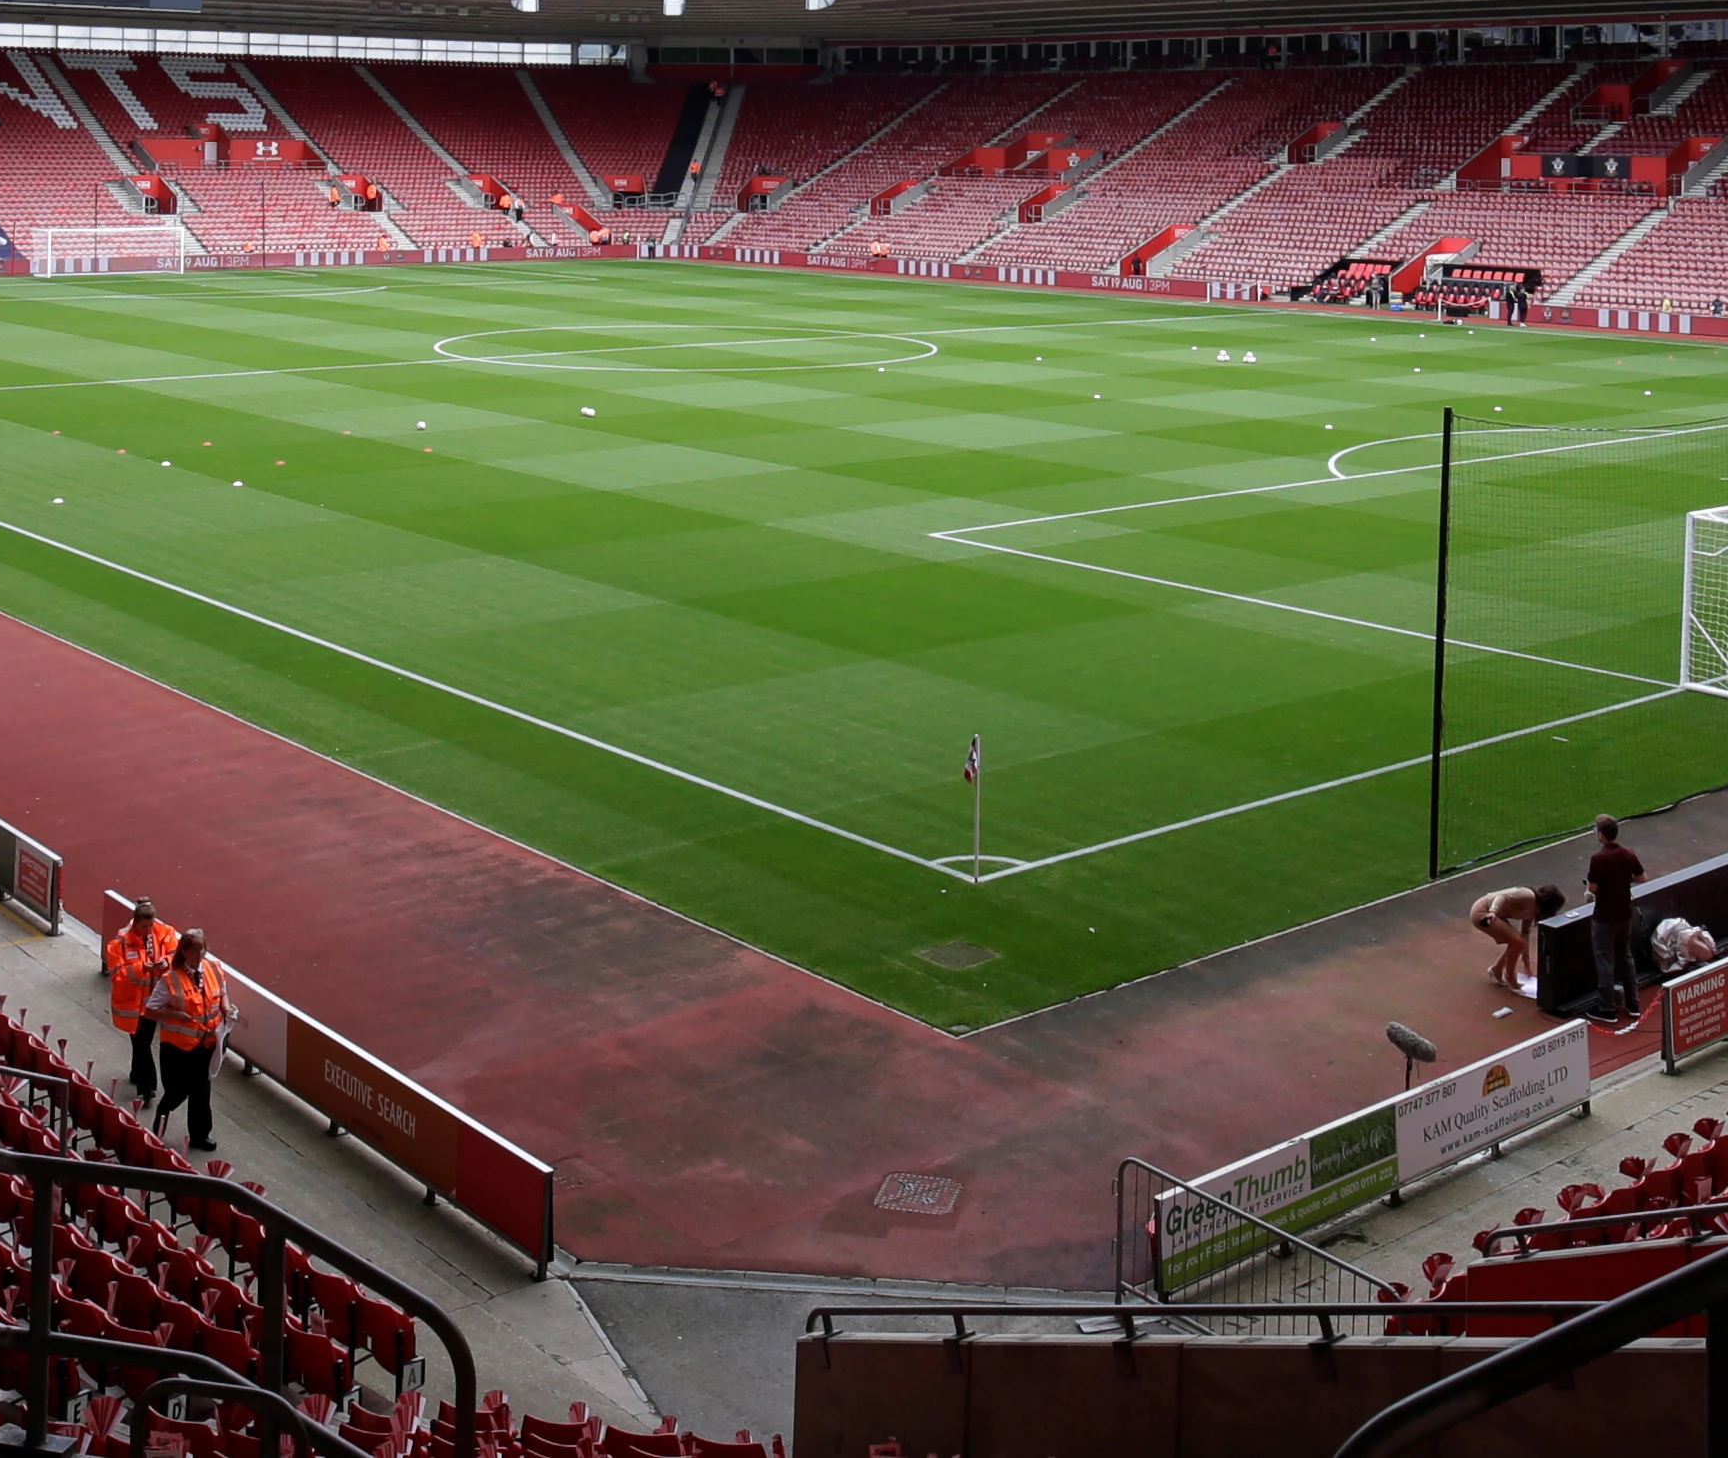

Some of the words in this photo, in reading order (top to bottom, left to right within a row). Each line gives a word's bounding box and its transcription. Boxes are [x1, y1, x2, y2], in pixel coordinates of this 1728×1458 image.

[157, 257, 179, 268] SAT
[194, 256, 217, 267] AUG
[526, 248, 543, 258] SAT
[1091, 275, 1111, 287] SAT
[1122, 278, 1143, 289] AUG
[1150, 279, 1170, 292] 3PM
[1677, 973, 1725, 1004] WARNING
[1532, 1043, 1547, 1060] 023
[324, 1058, 373, 1110] EXECUTIVE
[377, 1093, 416, 1139] SEARCH
[1397, 1097, 1423, 1118] 07747
[1425, 1088, 1440, 1106] 377
[1422, 1114, 1453, 1142] KAM
[1454, 1102, 1490, 1130] Quality
[1492, 1076, 1546, 1113] Scaffolding
[1547, 1065, 1568, 1088] LTD
[1440, 1095, 1555, 1155] www.kam-scaffolding.co.uk
[1165, 1154, 1308, 1237] GreenThumb
[1173, 1230, 1200, 1248] LAWN
[1263, 1182, 1305, 1206] SERVICE
[1167, 1258, 1183, 1276] For
[1185, 1252, 1205, 1272] your
[1205, 1239, 1230, 1261] FREE
[1297, 1199, 1321, 1220] quote
[1340, 1182, 1359, 1199] 0800
[1379, 1165, 1394, 1181] 222
